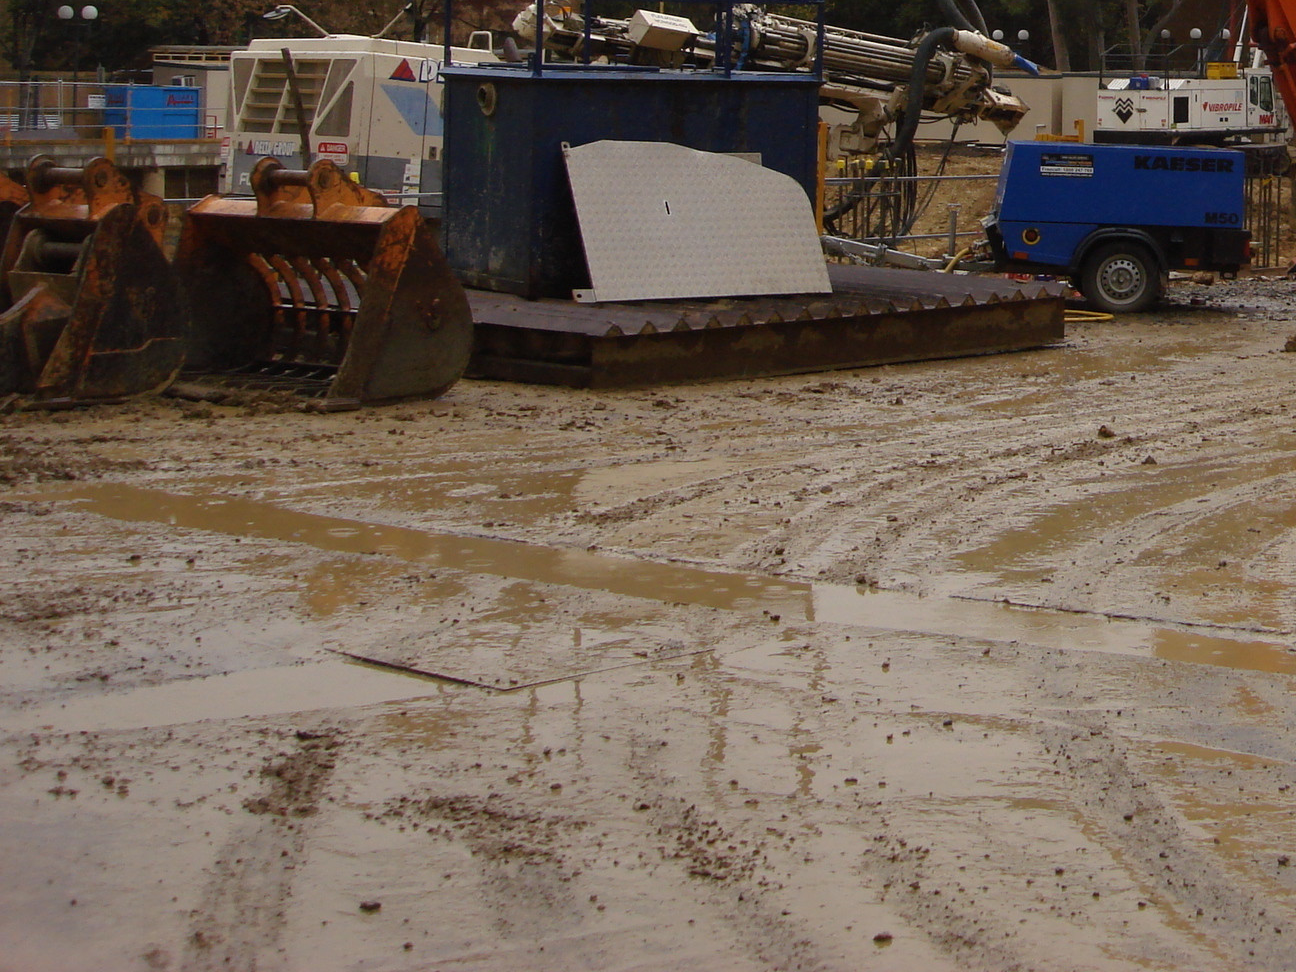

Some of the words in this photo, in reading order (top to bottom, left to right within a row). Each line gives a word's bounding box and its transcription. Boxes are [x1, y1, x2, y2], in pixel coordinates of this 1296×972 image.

[1208, 102, 1243, 112] VIBROPILE
[253, 140, 271, 156] DELTA
[273, 141, 296, 157] GROUP
[1133, 155, 1235, 174] KAESER
[1204, 212, 1240, 225] M50
